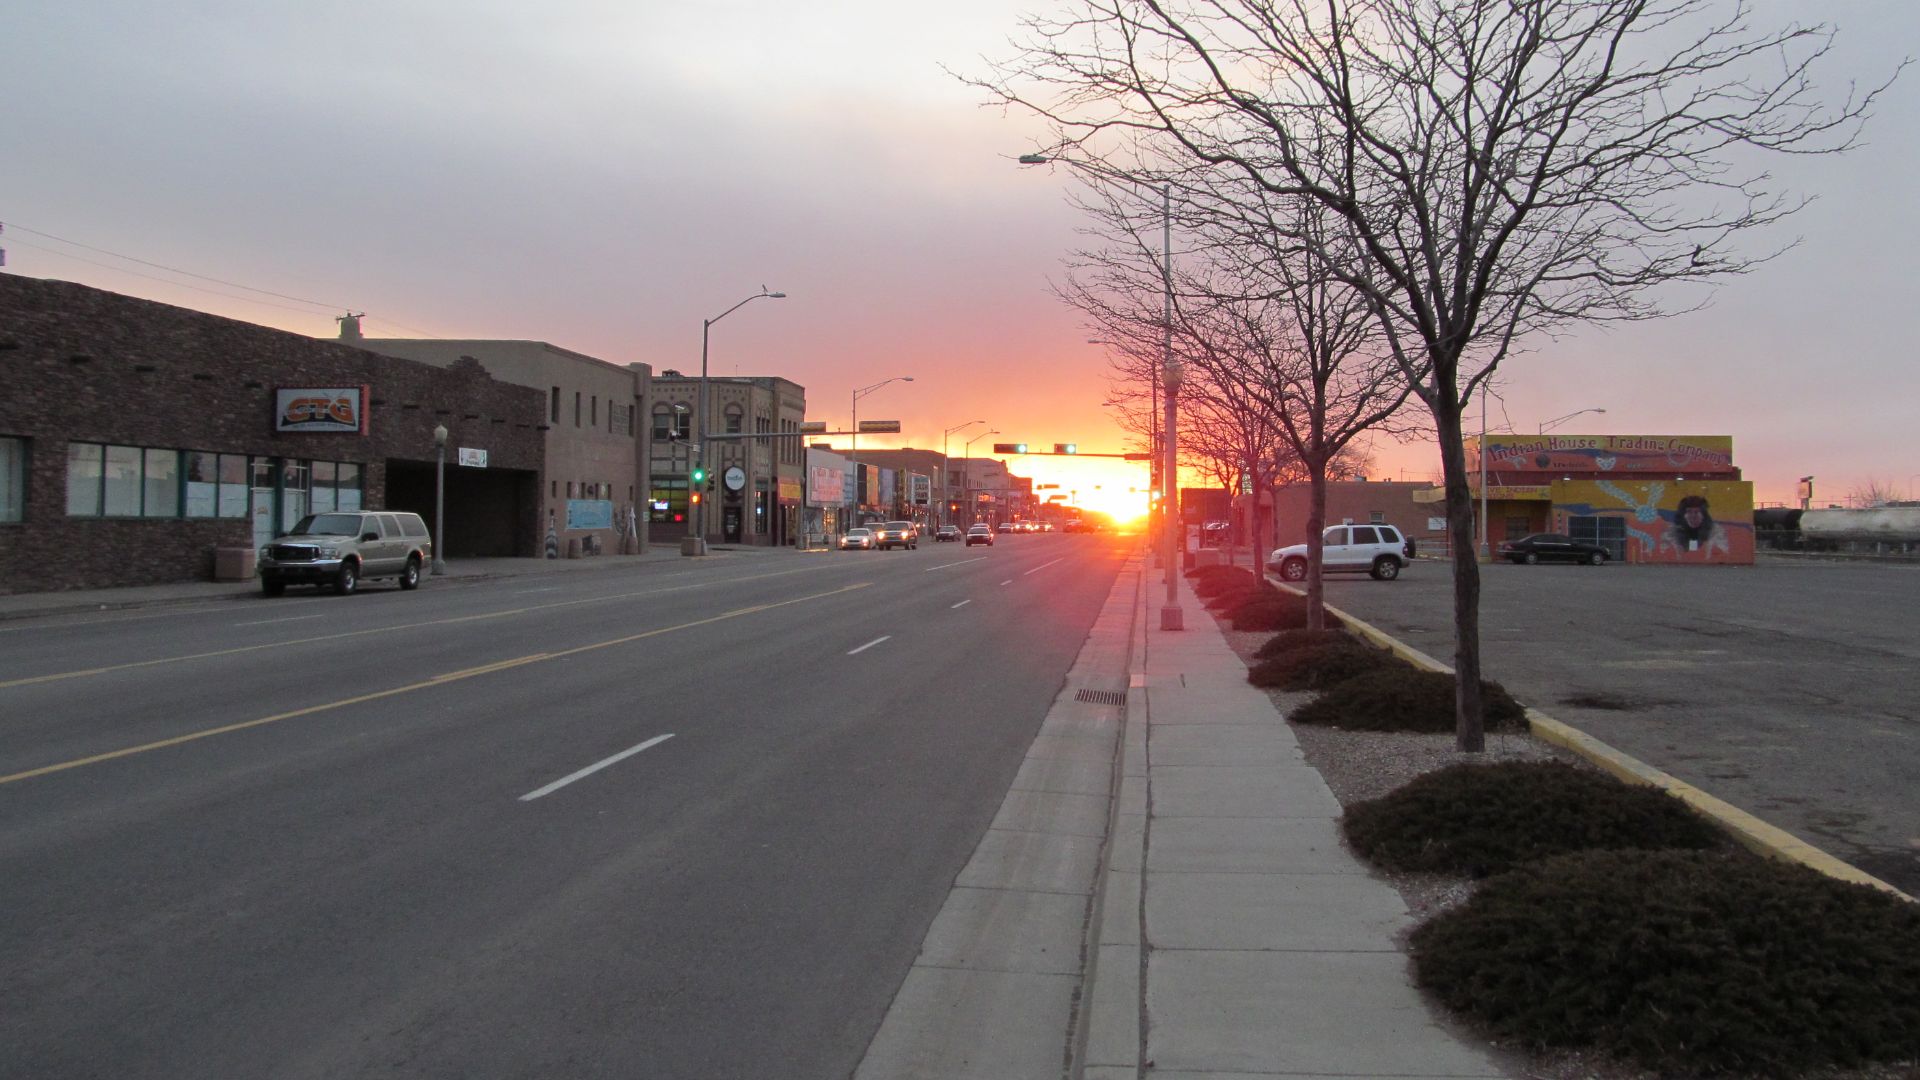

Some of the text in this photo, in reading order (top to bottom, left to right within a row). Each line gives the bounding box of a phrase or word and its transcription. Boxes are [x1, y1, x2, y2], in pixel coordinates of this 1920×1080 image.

[1489, 441, 1544, 461] Indian
[1549, 438, 1596, 449] House
[1608, 436, 1664, 450] Trading
[1668, 438, 1728, 466] Company
